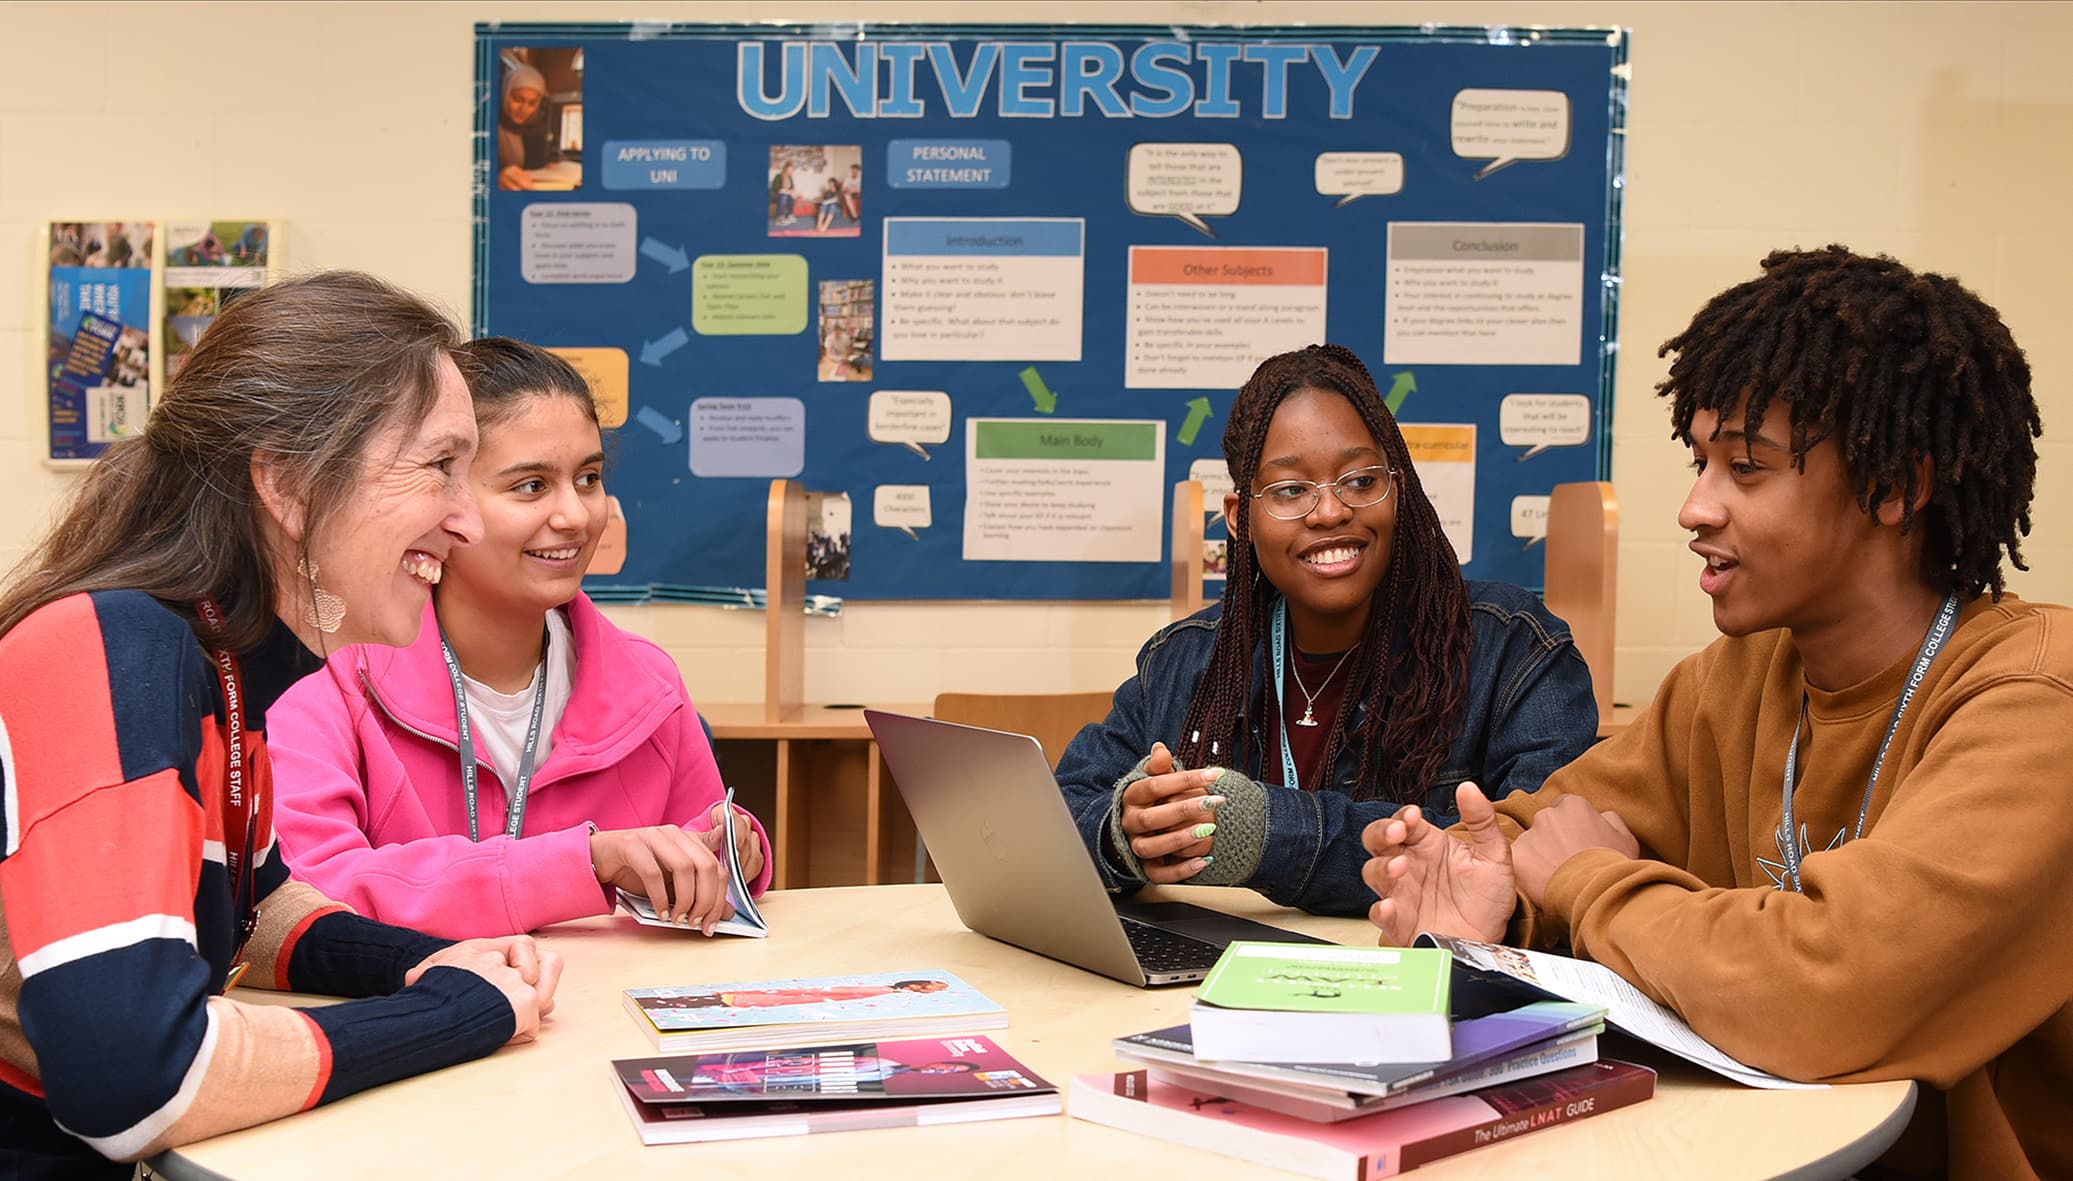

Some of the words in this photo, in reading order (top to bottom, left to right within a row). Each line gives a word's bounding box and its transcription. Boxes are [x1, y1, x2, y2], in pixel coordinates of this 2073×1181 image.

[737, 41, 1382, 120] UNIVERSITY
[618, 147, 687, 161] APPLYING
[692, 147, 711, 161] TO
[912, 147, 986, 161] PERSONAL
[650, 169, 678, 184] UNI
[906, 169, 992, 183] STATEMENT
[946, 235, 1024, 247] Introduction
[1452, 240, 1519, 252] Conclusion
[1183, 264, 1218, 276] Other
[1222, 264, 1273, 278] Subjects
[1040, 435, 1070, 447] Main
[1074, 435, 1104, 449] Body
[1910, 656, 1931, 689] FORM
[1925, 612, 1951, 657] COLLEGE
[224, 674, 240, 709] FORM
[449, 663, 463, 701] COLLEGE
[459, 701, 469, 741] STUDENT
[530, 707, 539, 731] ROAD
[229, 711, 241, 768] COLLEGE
[526, 732, 536, 753] HILLS
[229, 770, 241, 807] STAFF
[1288, 768, 1296, 786] ORM
[513, 775, 527, 813] STUDENT
[509, 815, 520, 840] LEGE
[1783, 811, 1792, 842] HILLS
[1786, 843, 1798, 874] ROAD
[1793, 875, 1802, 893] SIX
[1507, 1056, 1538, 1072] Practice
[1540, 1048, 1577, 1064] Questions
[1474, 1129, 1490, 1144] The
[1493, 1119, 1529, 1139] Ultimate
[1530, 1107, 1562, 1128] LNAT
[1566, 1097, 1595, 1118] GUIDE
